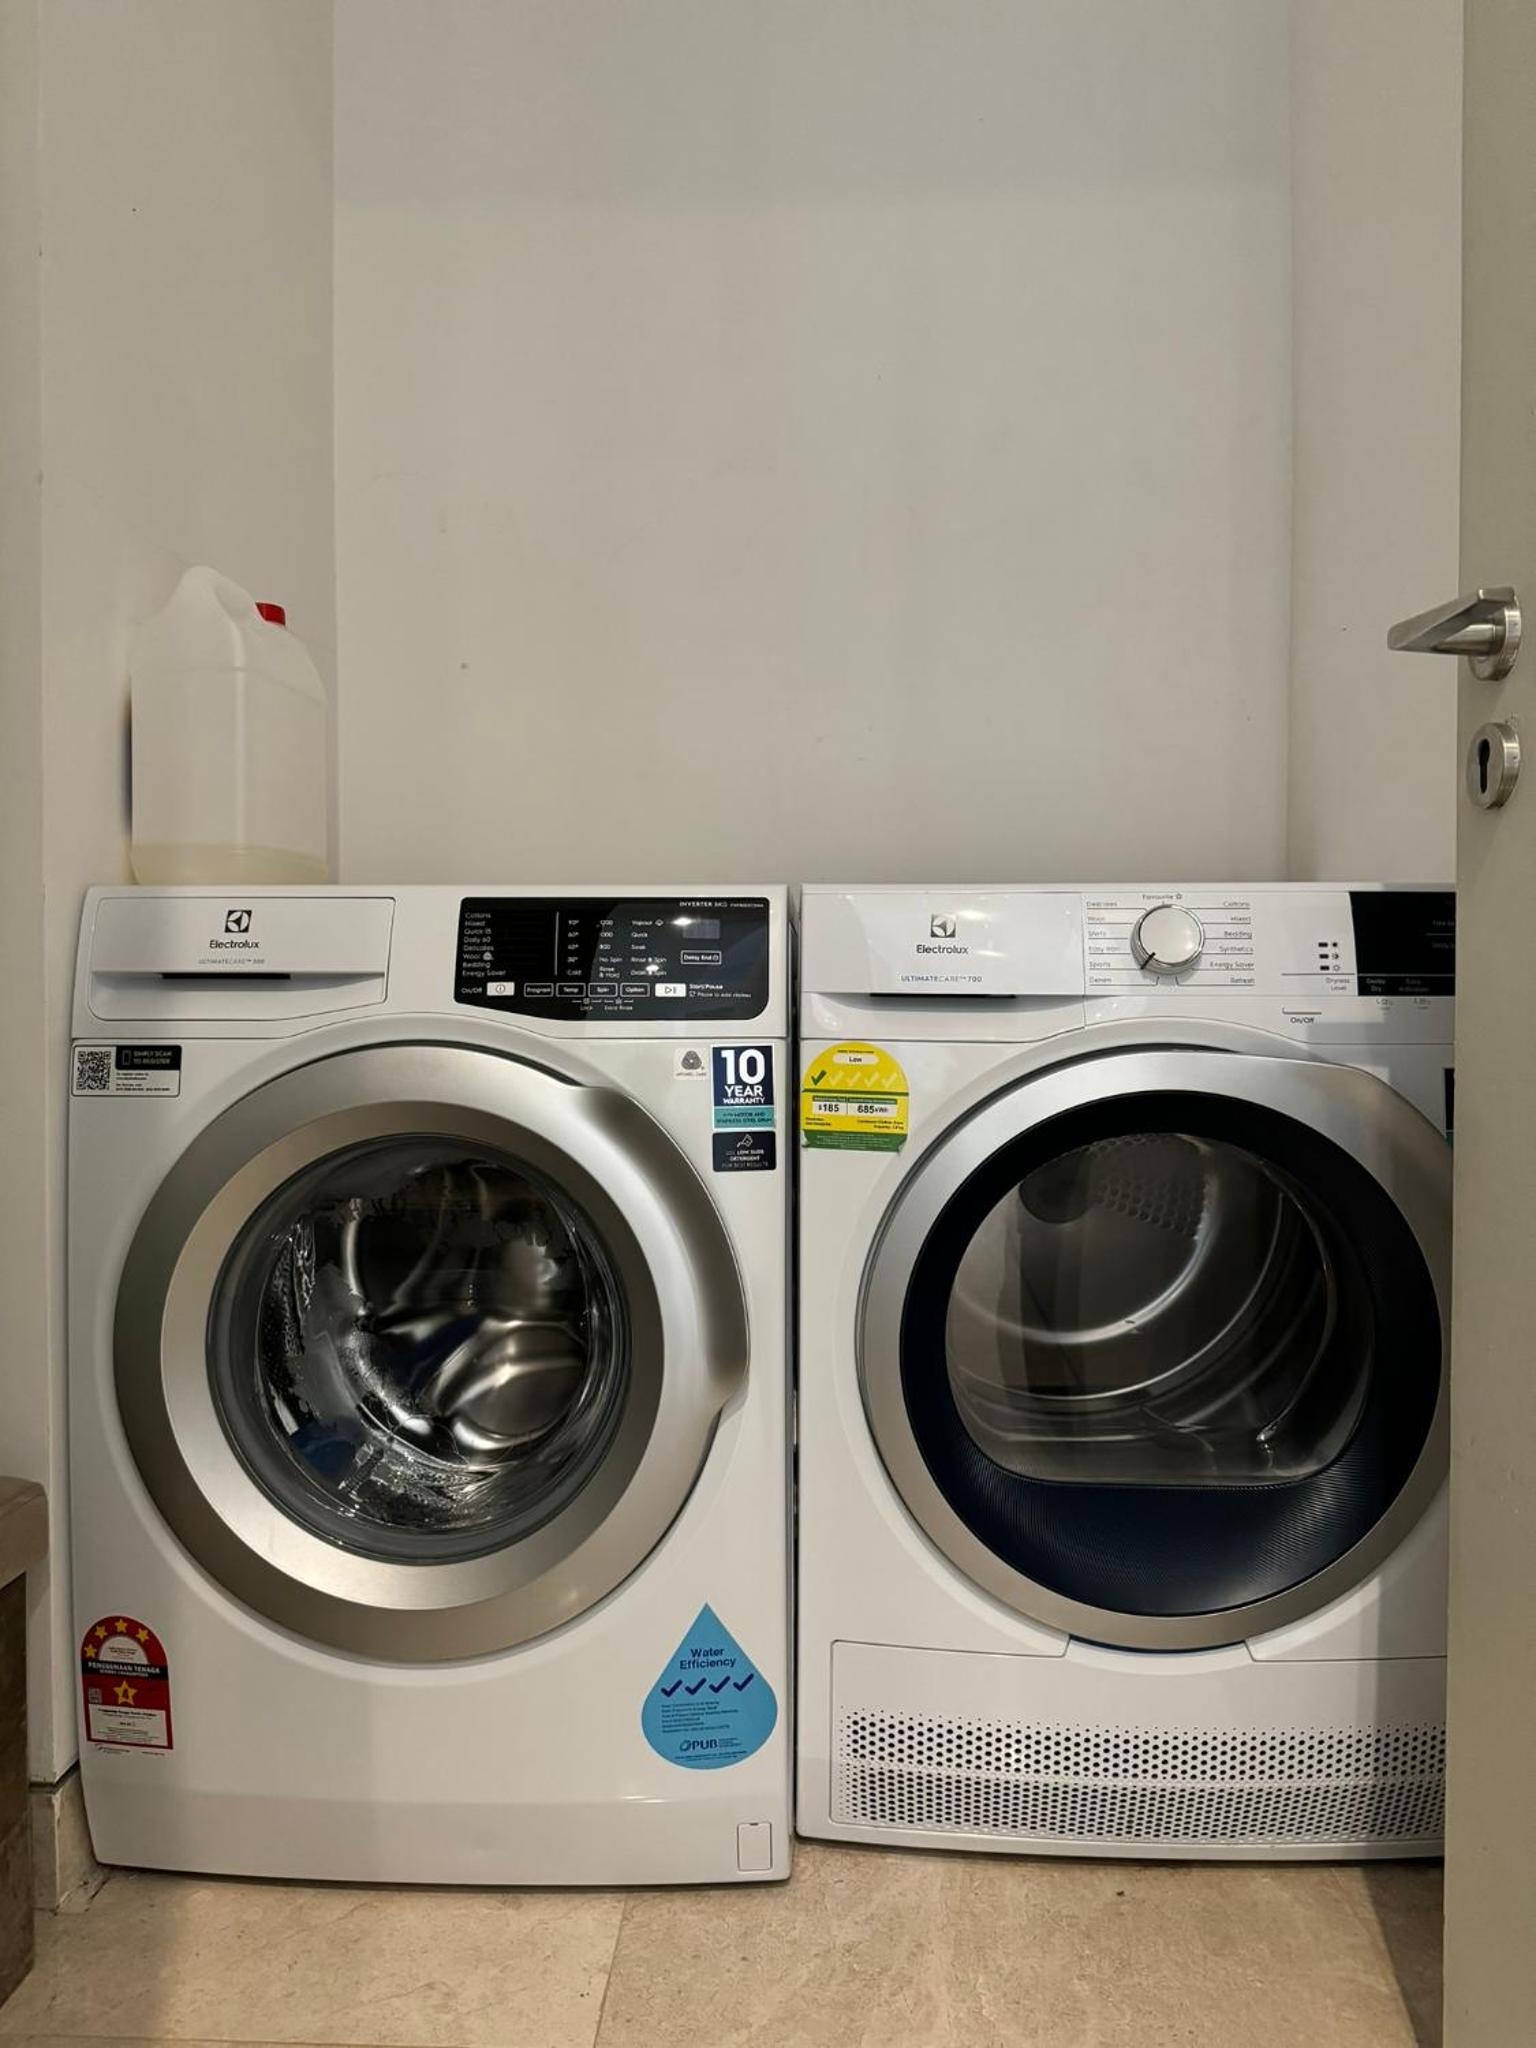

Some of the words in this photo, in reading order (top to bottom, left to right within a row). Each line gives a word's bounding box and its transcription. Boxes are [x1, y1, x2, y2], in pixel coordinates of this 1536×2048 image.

[209, 939, 259, 950] Electrolux
[463, 936, 481, 944] Daily
[916, 944, 969, 954] Electrolux
[1210, 962, 1234, 970] Energy
[462, 970, 485, 978] Energy
[720, 1048, 765, 1085] 10
[724, 1085, 763, 1098] YEAR
[690, 1648, 725, 1658] Water
[680, 1657, 737, 1669] Efficiency
[134, 1665, 161, 1674] TENAGA
[691, 1739, 718, 1750] PUB
